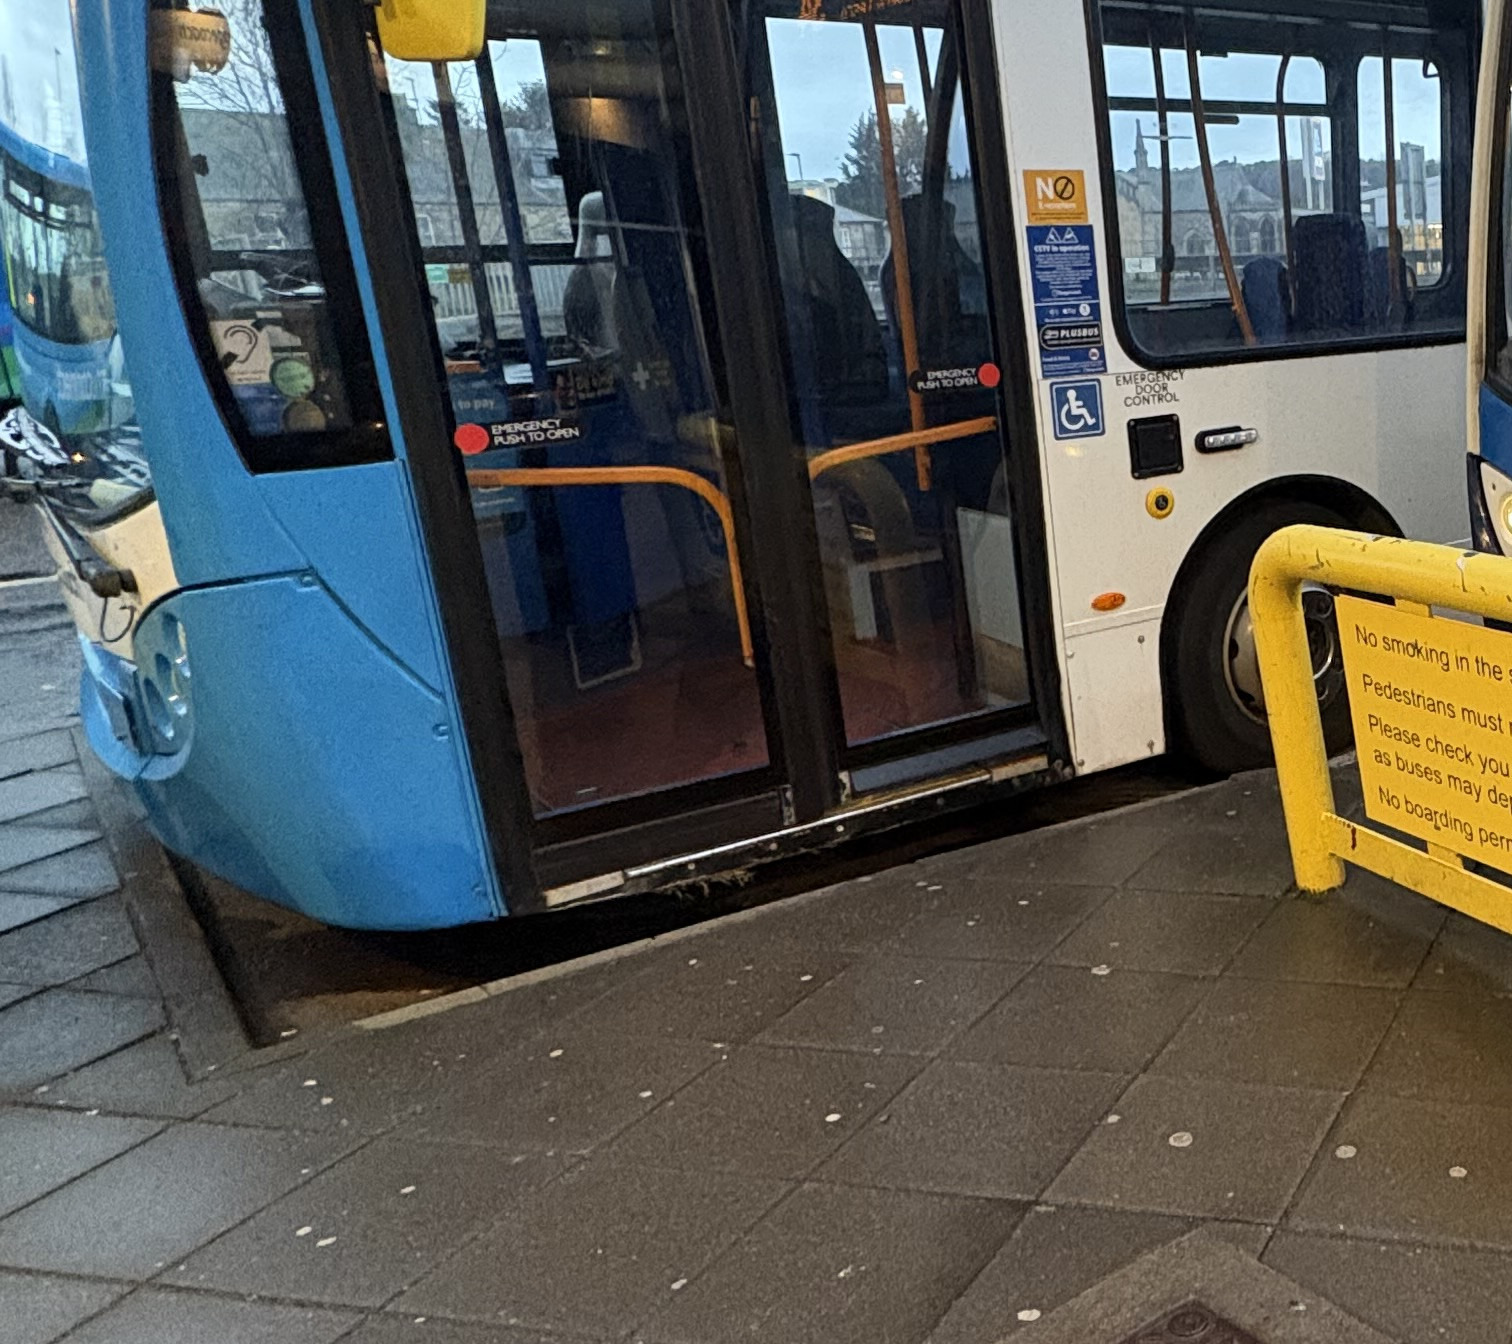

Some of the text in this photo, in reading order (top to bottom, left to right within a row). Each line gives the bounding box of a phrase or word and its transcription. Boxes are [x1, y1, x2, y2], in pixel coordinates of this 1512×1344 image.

[917, 376, 978, 390] PUSH TO OPEN
[927, 368, 976, 380] EMERGENCY
[1115, 368, 1185, 387] EMERGENCY
[1135, 382, 1169, 395] DOOR
[1124, 392, 1180, 407] CONTROL
[491, 418, 561, 436] EMERGENCY
[493, 426, 580, 446] PUSH TO OPEN
[1355, 624, 1377, 647] No
[1382, 636, 1450, 672] smoking
[1455, 655, 1469, 672] in
[1475, 656, 1503, 681] the
[1363, 673, 1456, 718] Pedestrians
[1461, 707, 1504, 734] must
[1368, 714, 1421, 748] Please
[1426, 735, 1474, 766] check
[1478, 754, 1510, 778] you
[1374, 749, 1391, 766] as
[1395, 752, 1442, 784] buses
[1447, 774, 1481, 803] may
[1379, 786, 1400, 810] No
[1404, 795, 1473, 842] boarding
